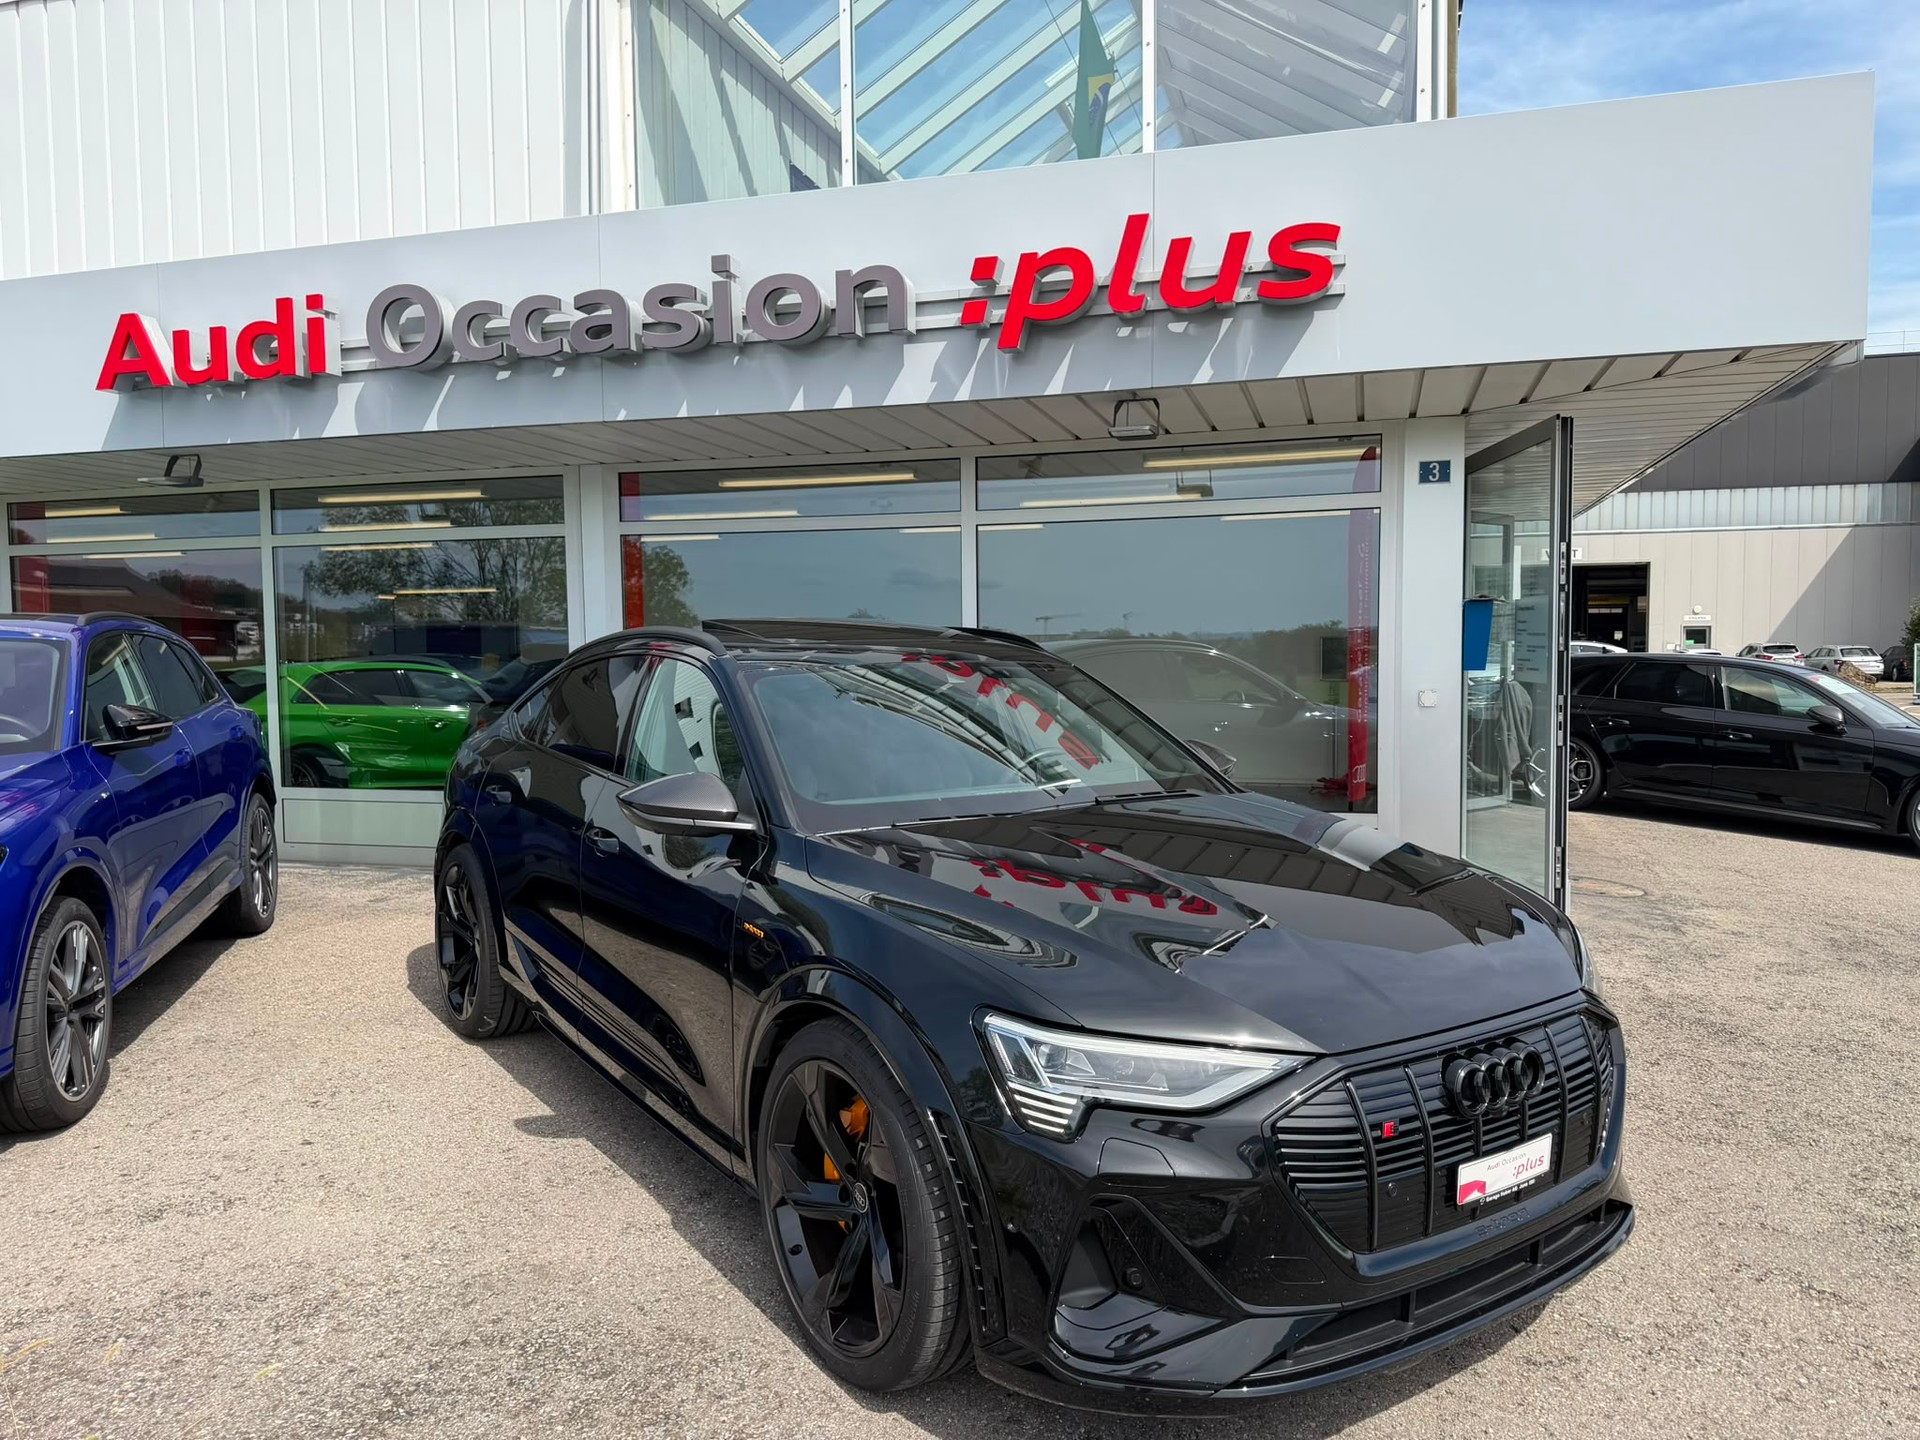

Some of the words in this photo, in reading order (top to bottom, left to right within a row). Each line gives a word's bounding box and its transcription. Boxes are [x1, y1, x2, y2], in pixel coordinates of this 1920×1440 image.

[96, 293, 327, 391] Audi
[365, 254, 910, 369] Occasion
[1428, 462, 1440, 482] 3
[1486, 1161, 1501, 1172] Audi
[1501, 1152, 1527, 1167] Occasion
